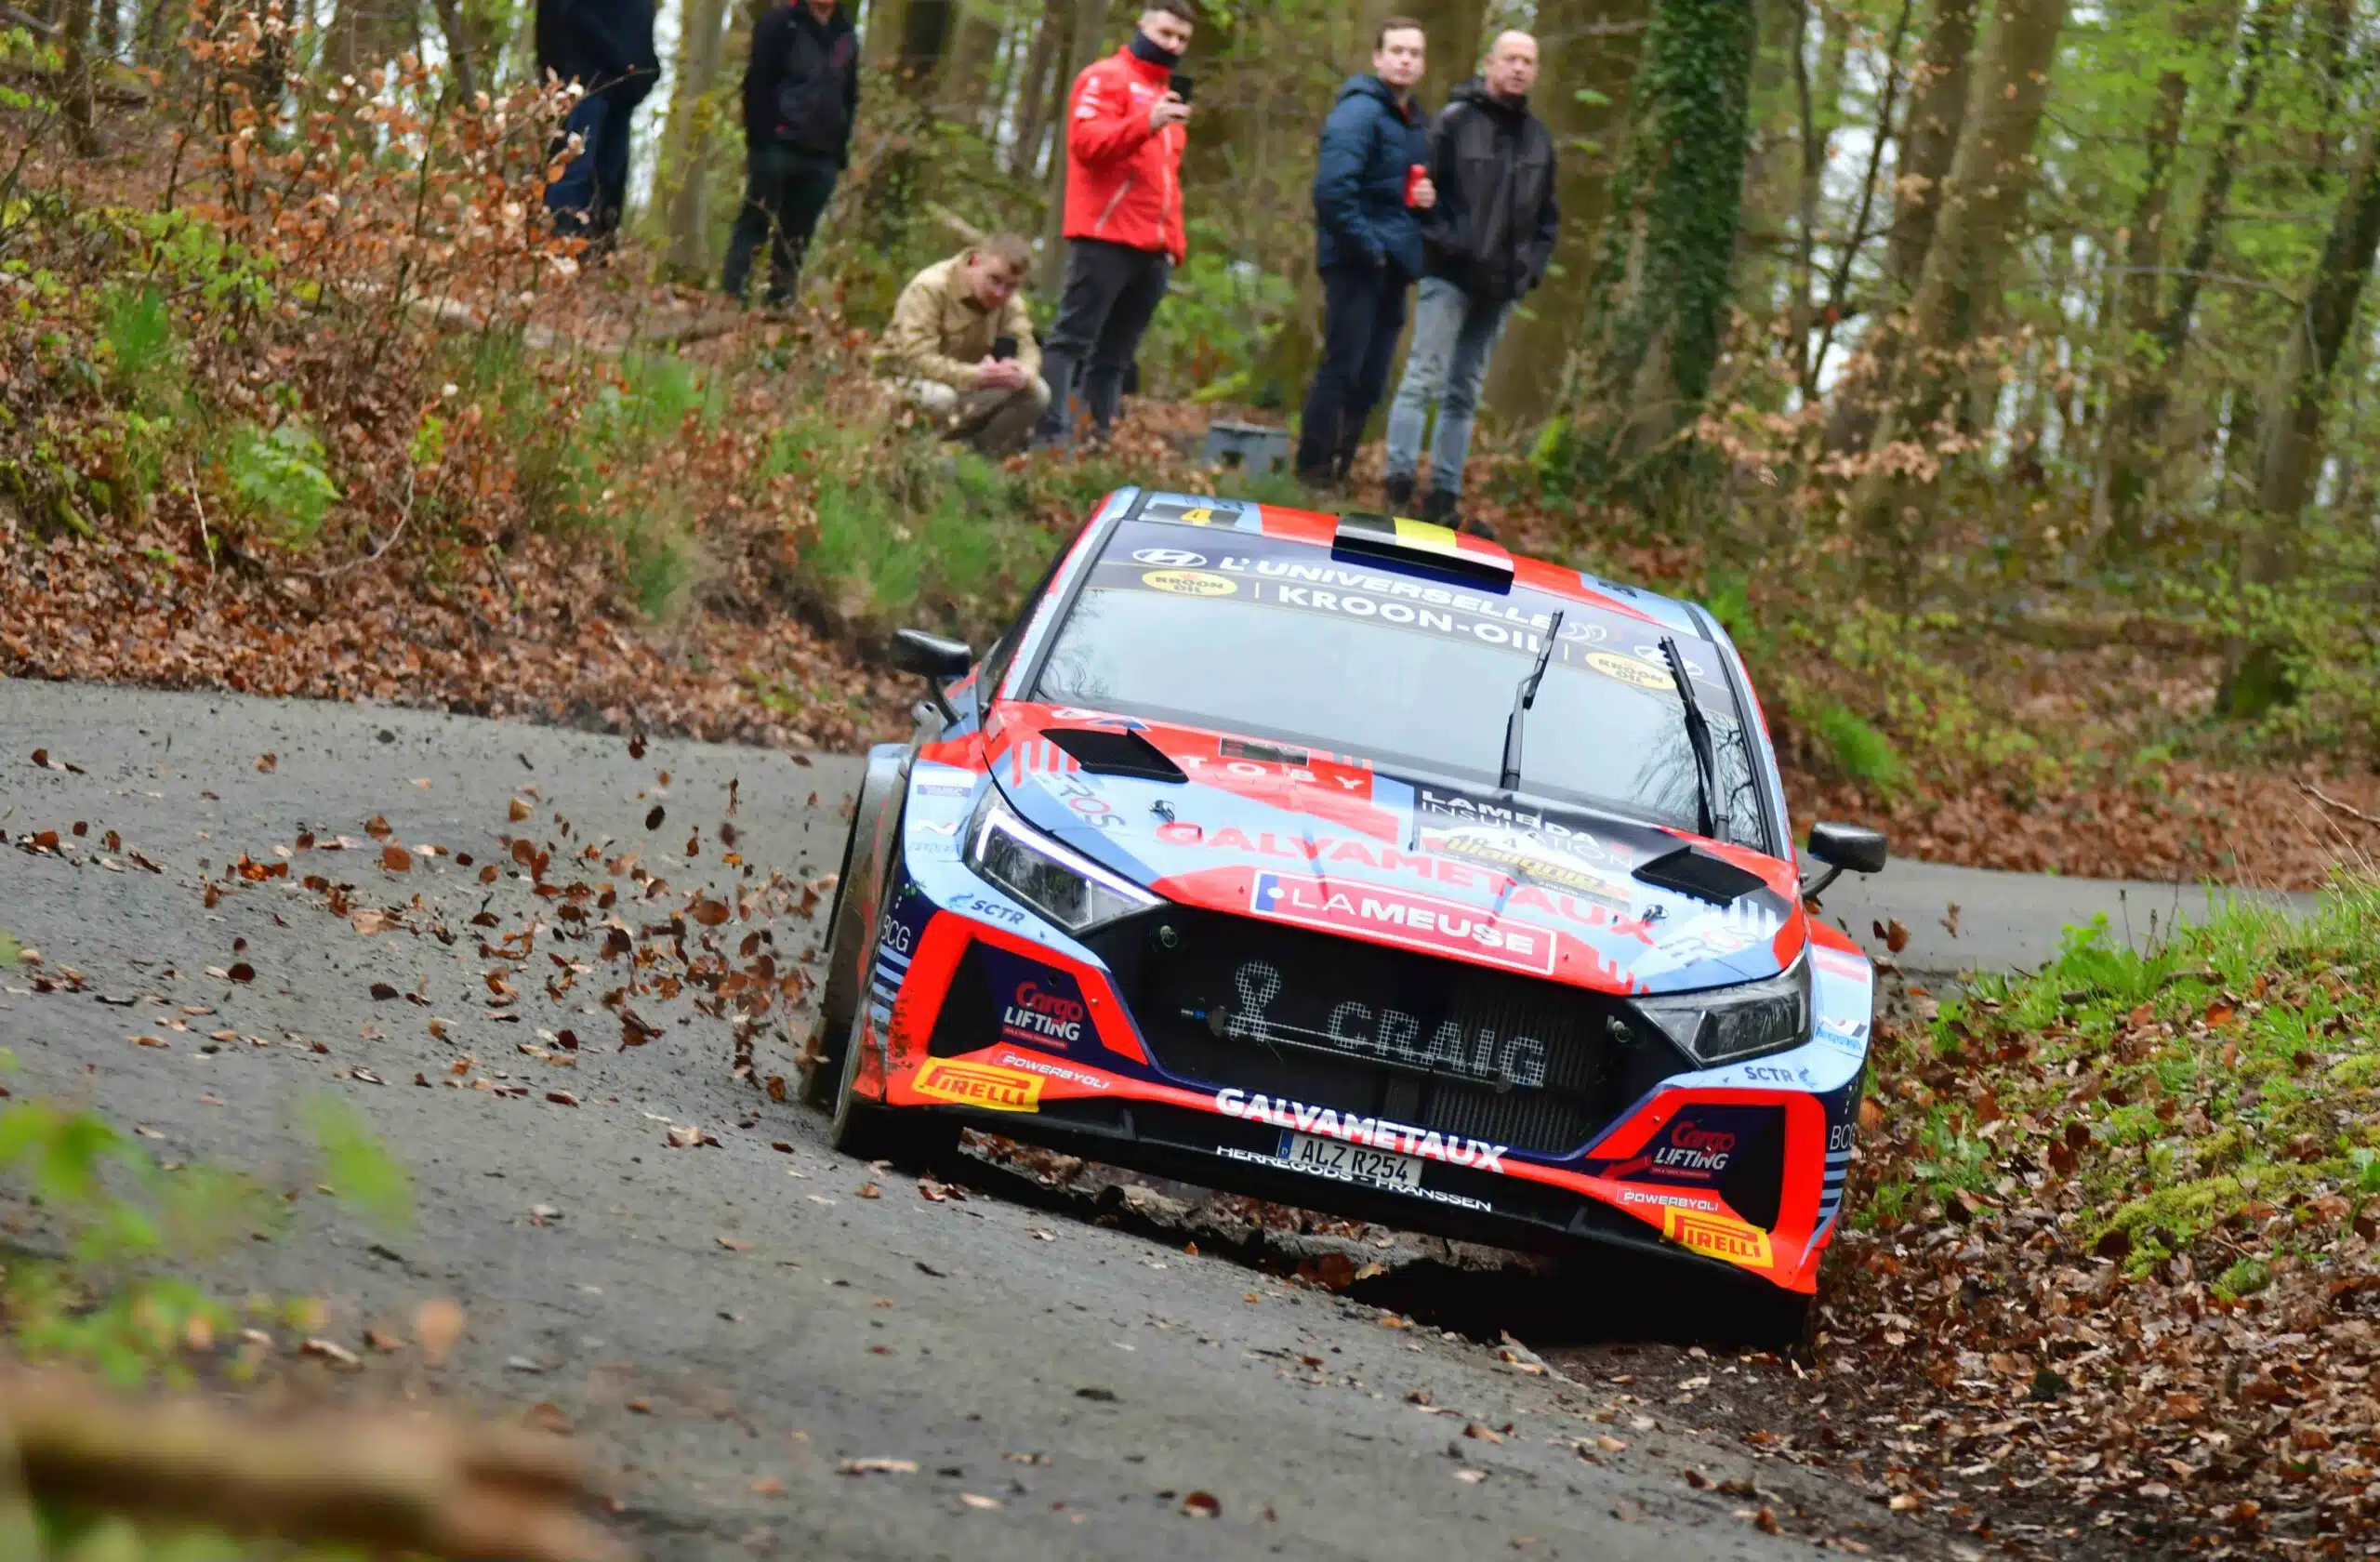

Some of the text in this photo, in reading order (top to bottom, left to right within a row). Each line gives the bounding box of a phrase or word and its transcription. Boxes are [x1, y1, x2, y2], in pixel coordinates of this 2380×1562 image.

[1180, 507, 1212, 525] 4
[1183, 755, 1364, 789] TOBY
[1421, 790, 1600, 849] LAMBDA
[1157, 822, 1656, 946] GALVAMETAUX
[971, 900, 1025, 925] SCTR
[1016, 981, 1084, 1026] Cargo
[1003, 1006, 1082, 1042] LIFTING
[1328, 1000, 1546, 1087] CRAIG
[926, 1065, 1032, 1106] PIRELLI
[1002, 1053, 1111, 1090] POWERBYOLI
[1744, 1066, 1794, 1083] SCTR
[1216, 1088, 1508, 1173] GALVAMETAUX
[1671, 1120, 1736, 1157] Cargo
[1301, 1139, 1408, 1183] ALZ R254
[1654, 1146, 1729, 1171] LIFTING
[1216, 1145, 1354, 1182] HERREGODS
[1375, 1180, 1491, 1212] FRANSSEN
[1624, 1191, 1719, 1211] POWERBYOLI
[1673, 1213, 1762, 1258] PIRELLI
